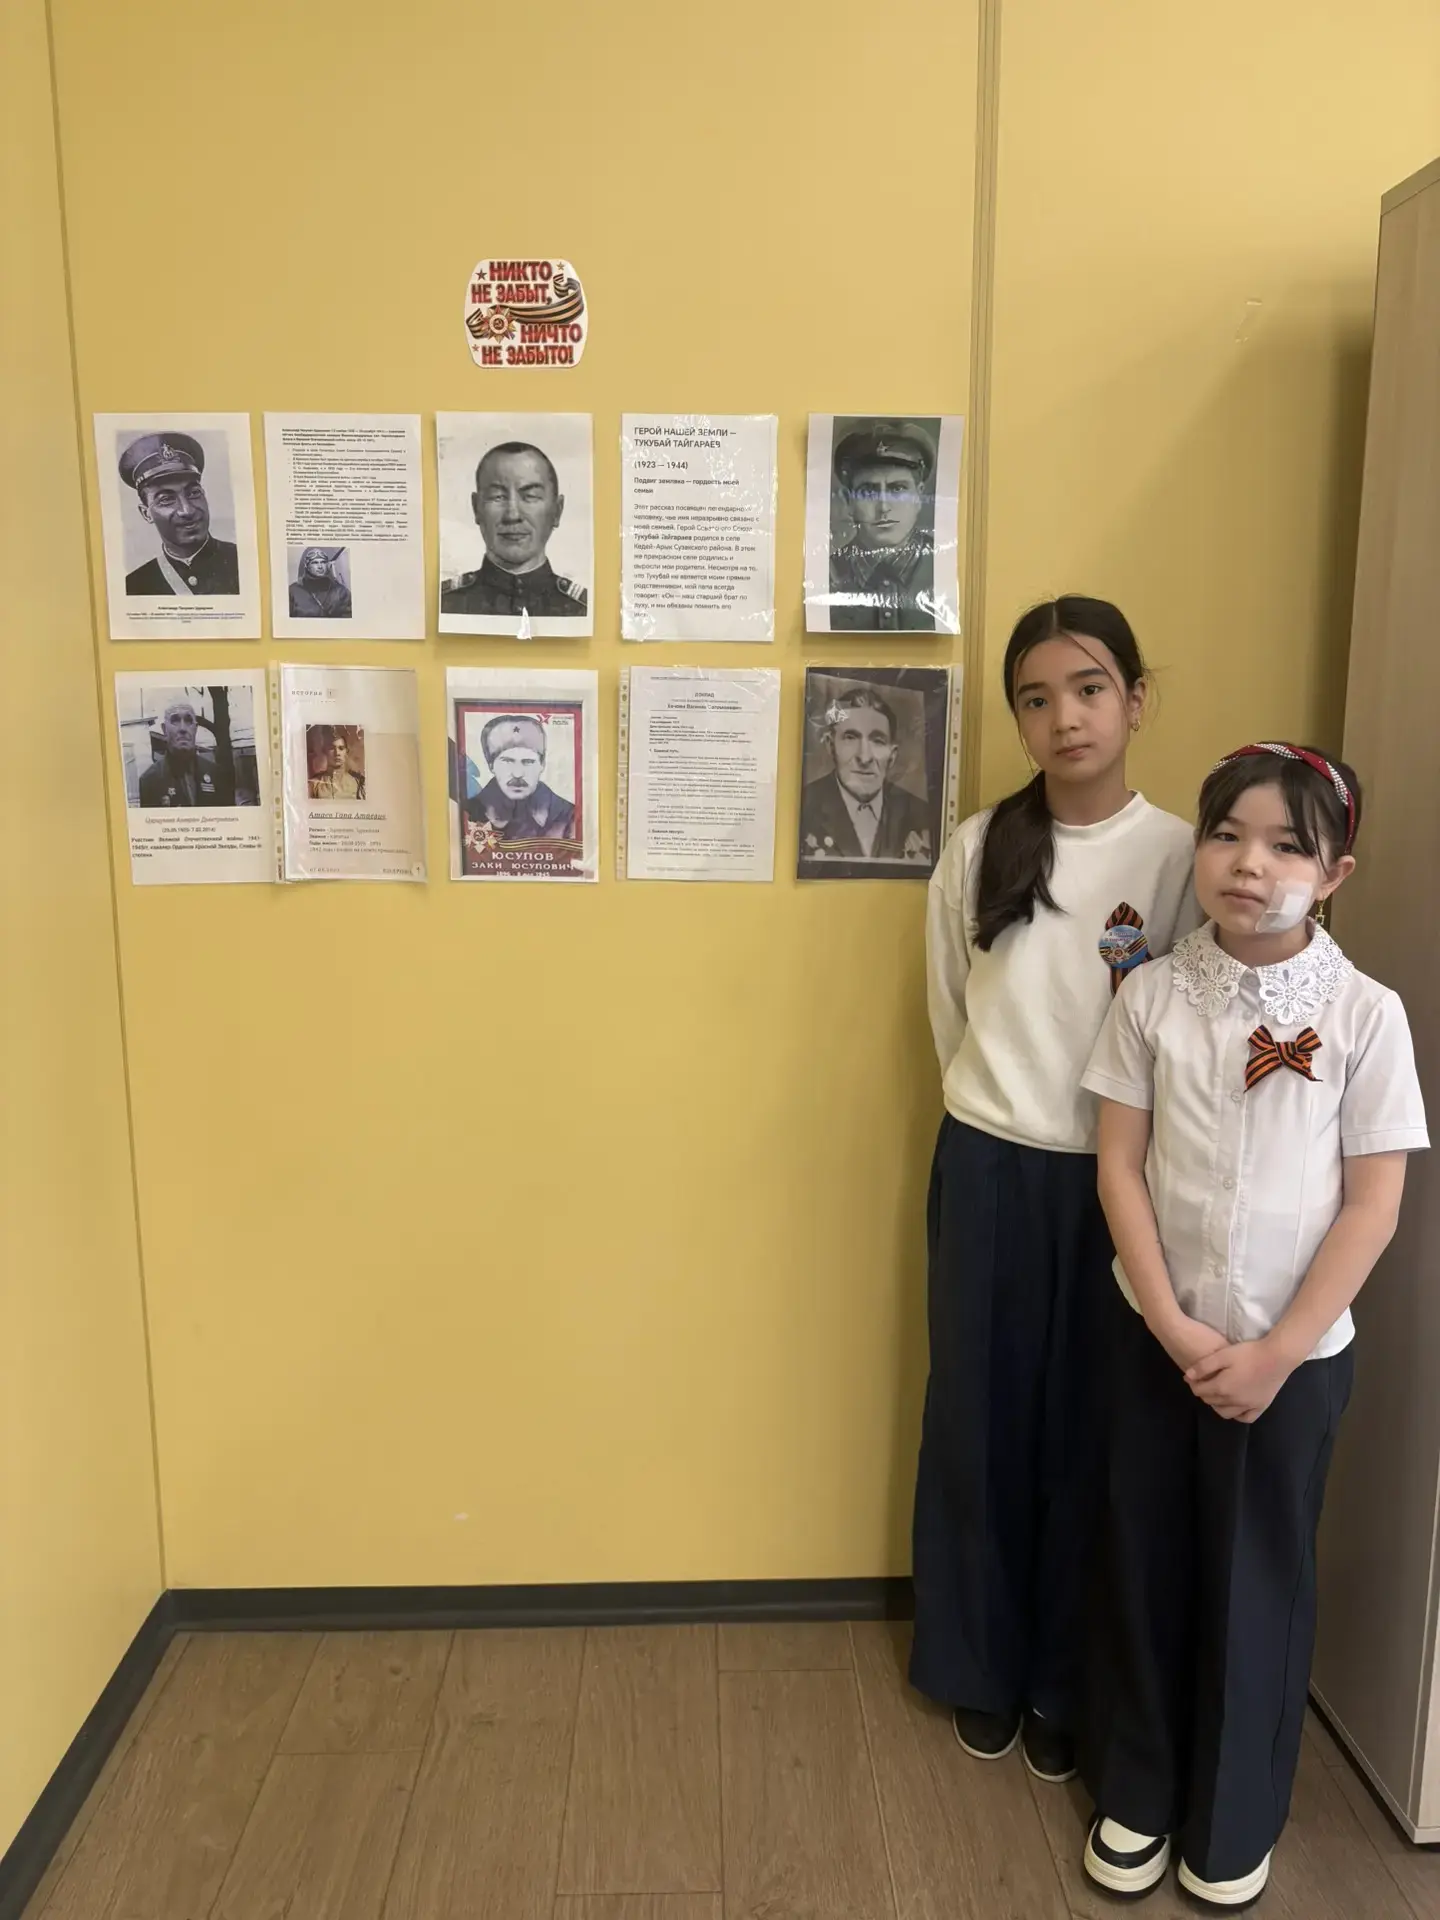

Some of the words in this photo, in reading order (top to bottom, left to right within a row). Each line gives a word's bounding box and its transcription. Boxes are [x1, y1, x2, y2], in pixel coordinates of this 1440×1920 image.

[489, 261, 552, 281] НИКТО
[471, 284, 492, 303] НЕ
[496, 284, 552, 305] ЗАБЫТ,
[520, 323, 583, 343] НИЧТО
[482, 345, 503, 365] НЕ
[506, 345, 574, 365] ЗАБЫТО!
[634, 426, 661, 435] ГЕРОЙ
[664, 427, 695, 436] НАШЕЙ
[698, 428, 728, 436] ЗЕМЛИ
[634, 438, 671, 447] ТУКУБАЙ
[673, 438, 721, 448] ТАЙГАРАЕВ
[634, 460, 656, 469] (1923
[667, 461, 688, 470] 1944)
[634, 533, 660, 541] Тукубай
[492, 852, 554, 860] ЮСУПОВ
[512, 862, 575, 870] ЮСУПОВИЧ
